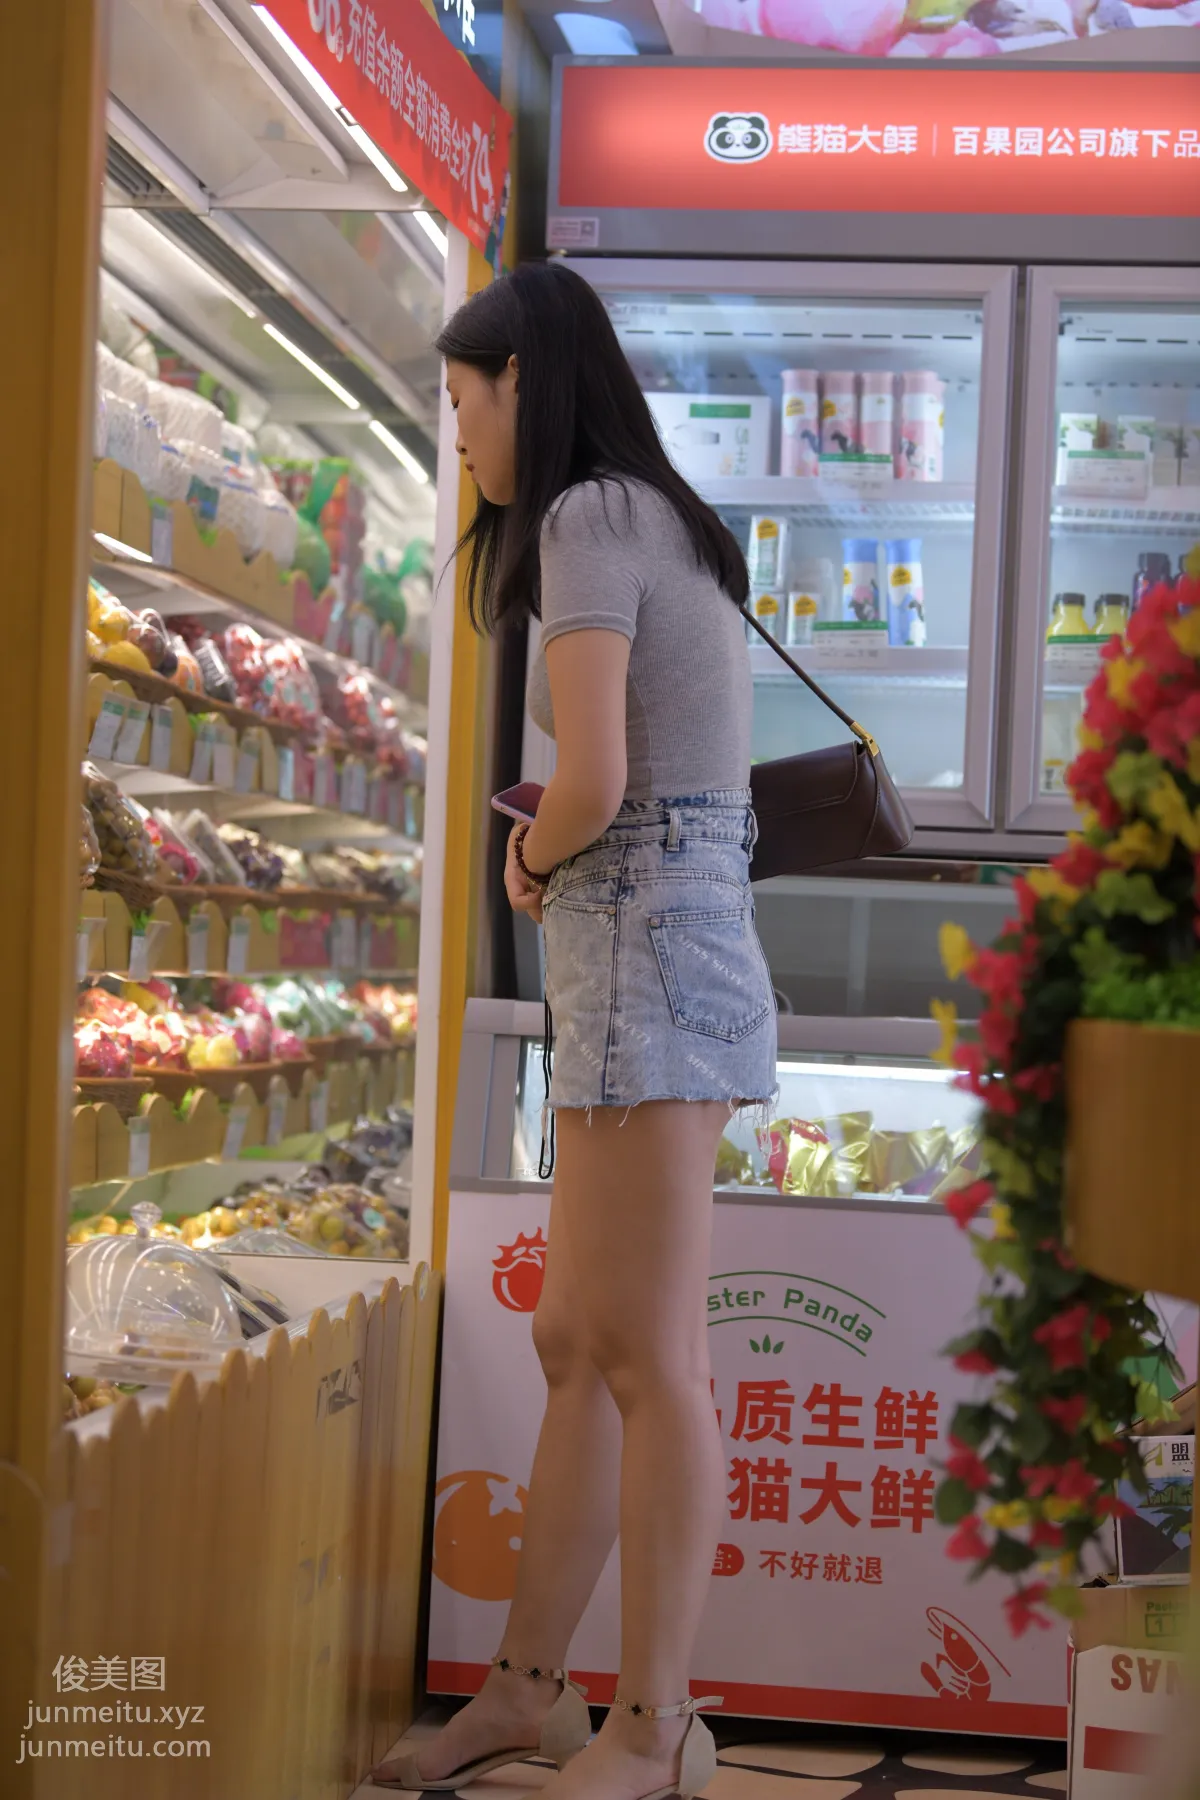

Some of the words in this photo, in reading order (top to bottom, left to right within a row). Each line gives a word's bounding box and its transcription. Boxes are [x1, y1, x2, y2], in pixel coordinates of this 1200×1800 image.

[778, 123, 918, 155] 熊猫大鲜
[952, 126, 1200, 158] 百果园公司旗下品
[783, 1288, 873, 1343] Panda
[709, 1378, 939, 1455] 质生鲜
[1171, 1442, 1190, 1461] 盟
[727, 1457, 935, 1533] 猫大鲜
[758, 1550, 884, 1585] 不好就退
